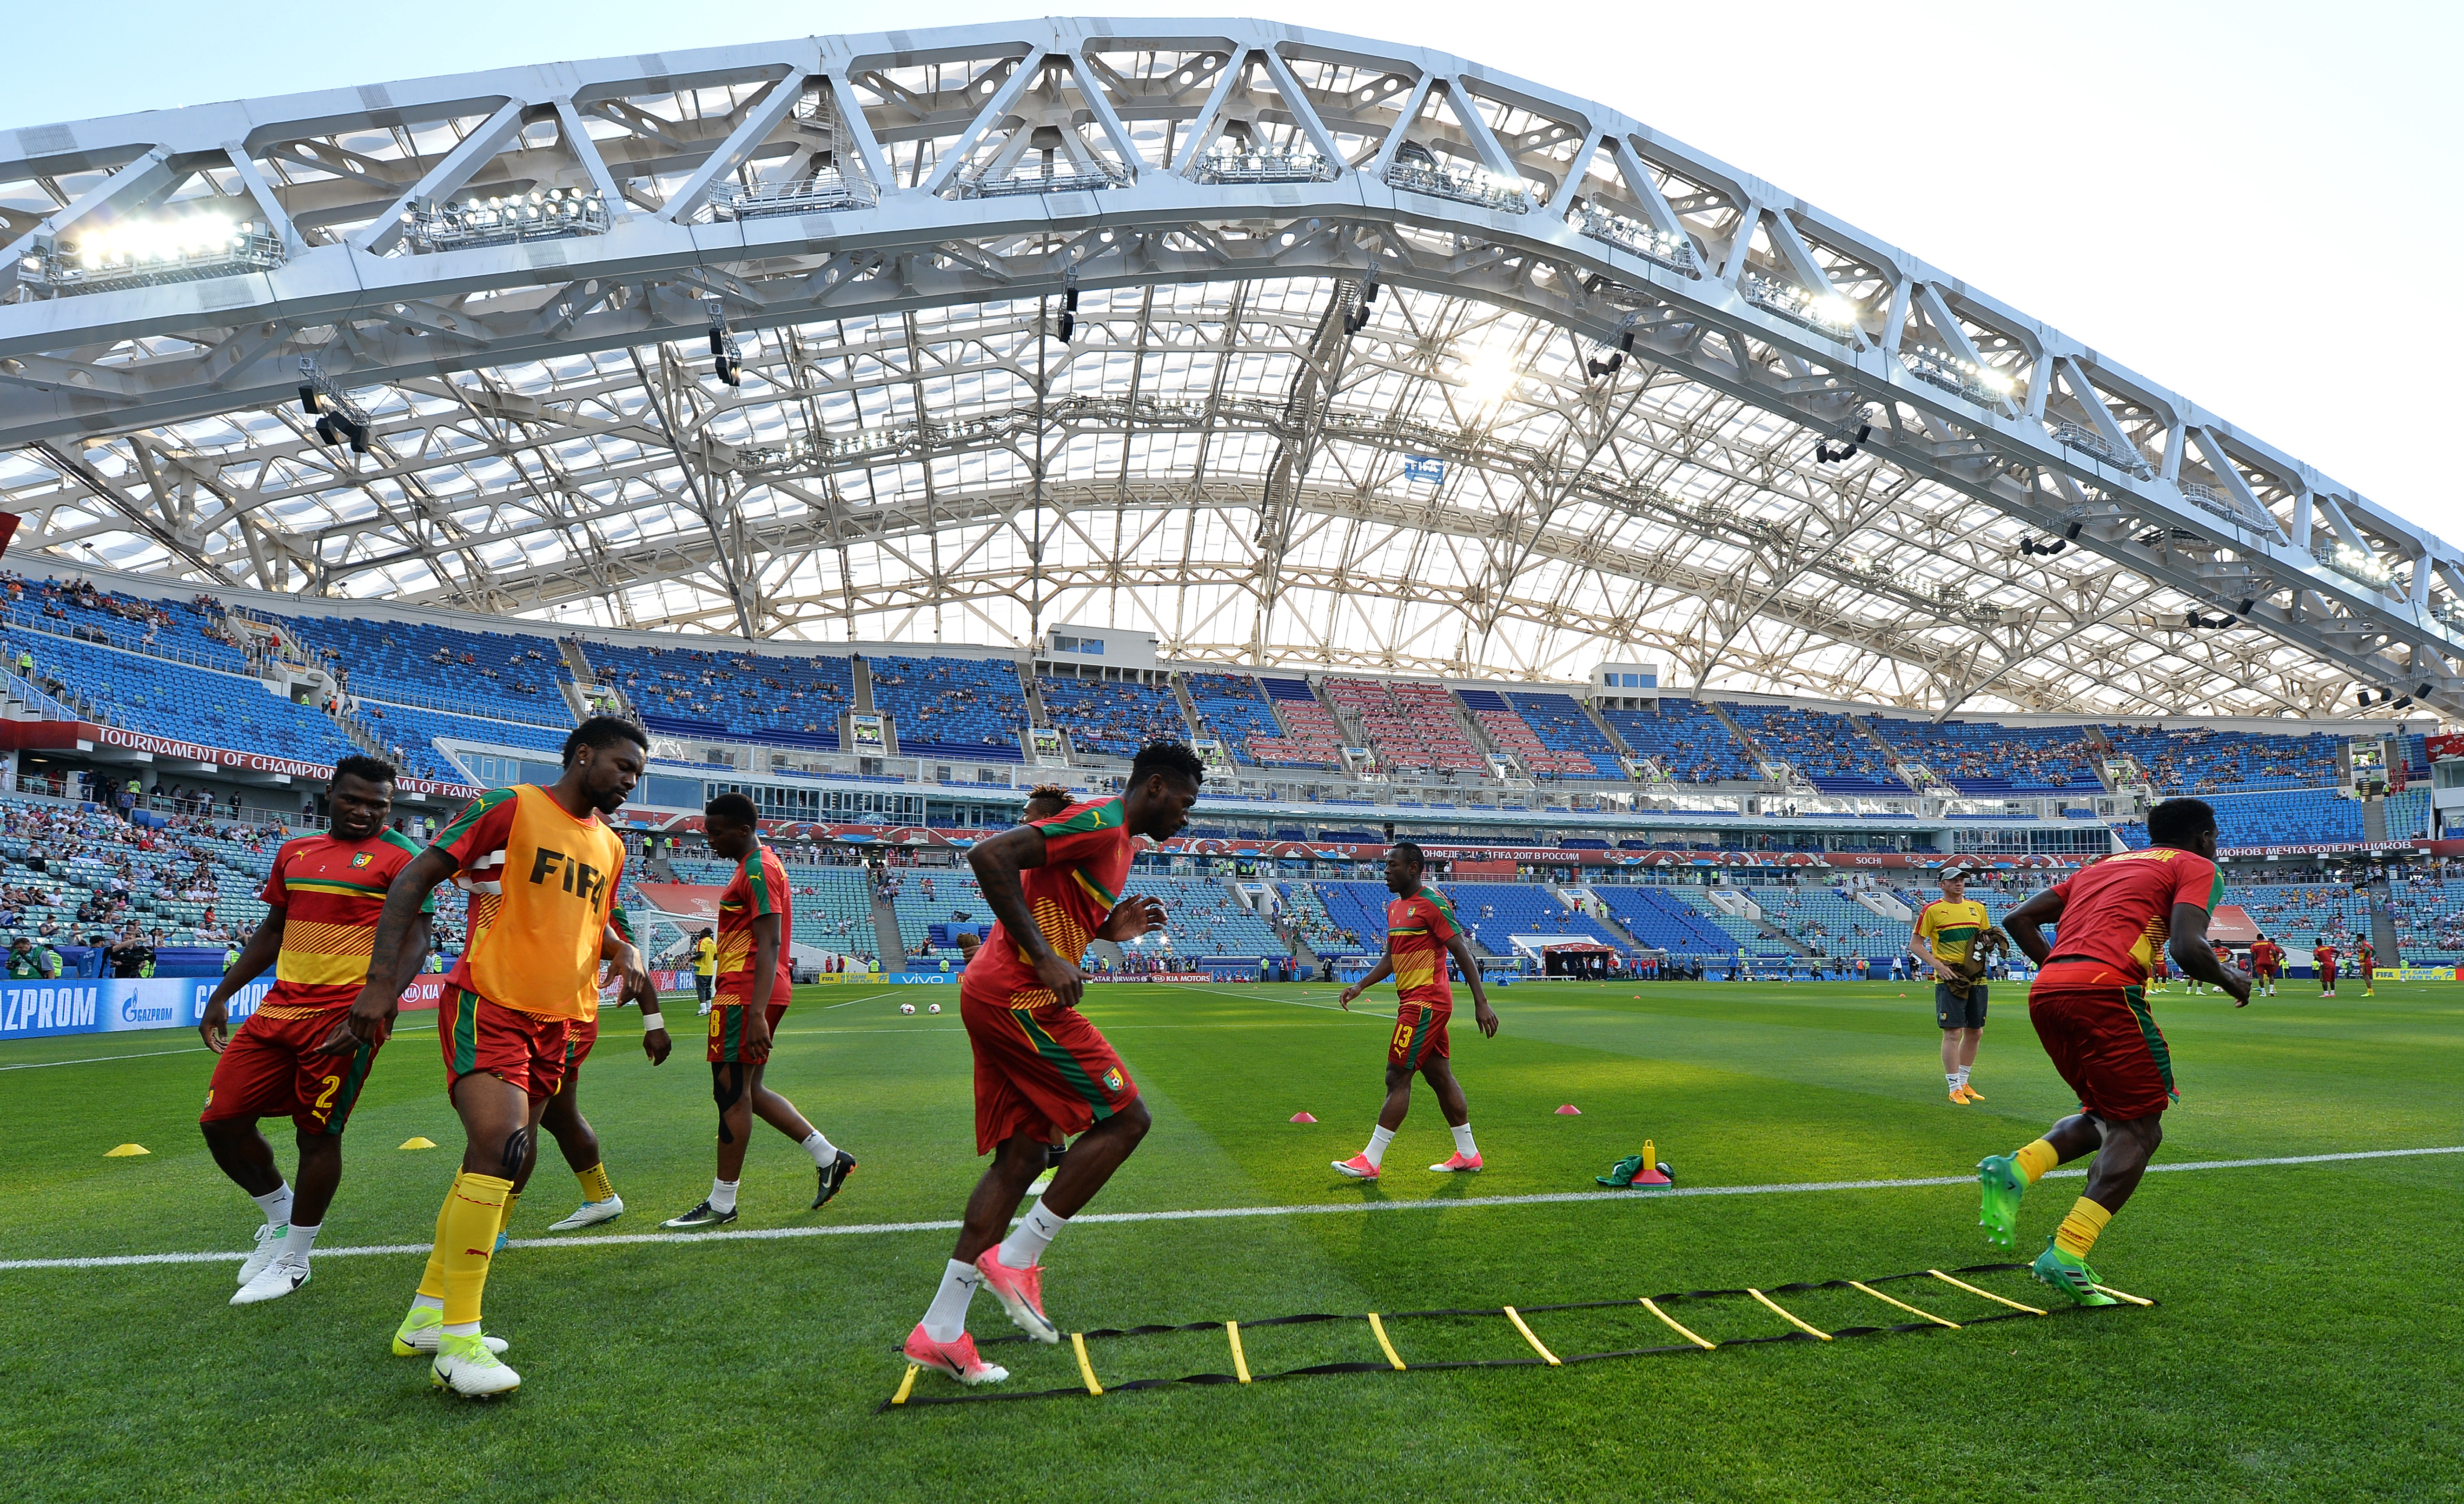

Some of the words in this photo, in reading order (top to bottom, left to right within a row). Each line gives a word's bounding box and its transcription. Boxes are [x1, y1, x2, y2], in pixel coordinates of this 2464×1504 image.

[1411, 461, 1439, 473] FIFA
[97, 727, 220, 763] TOURNAMENT
[223, 752, 248, 767] OF
[419, 781, 440, 793] OF
[442, 784, 481, 800] FANS
[2266, 846, 2306, 855] МЕЧТА
[529, 846, 606, 914] FIFA
[660, 972, 676, 991] Bud
[679, 972, 694, 989] FIFA
[902, 973, 943, 984] vivo
[422, 984, 439, 1000] KIA
[138, 1007, 172, 1022] GAZPROM
[710, 1009, 720, 1037] 8
[1393, 1023, 1413, 1048] 13
[315, 1075, 340, 1108] 2
